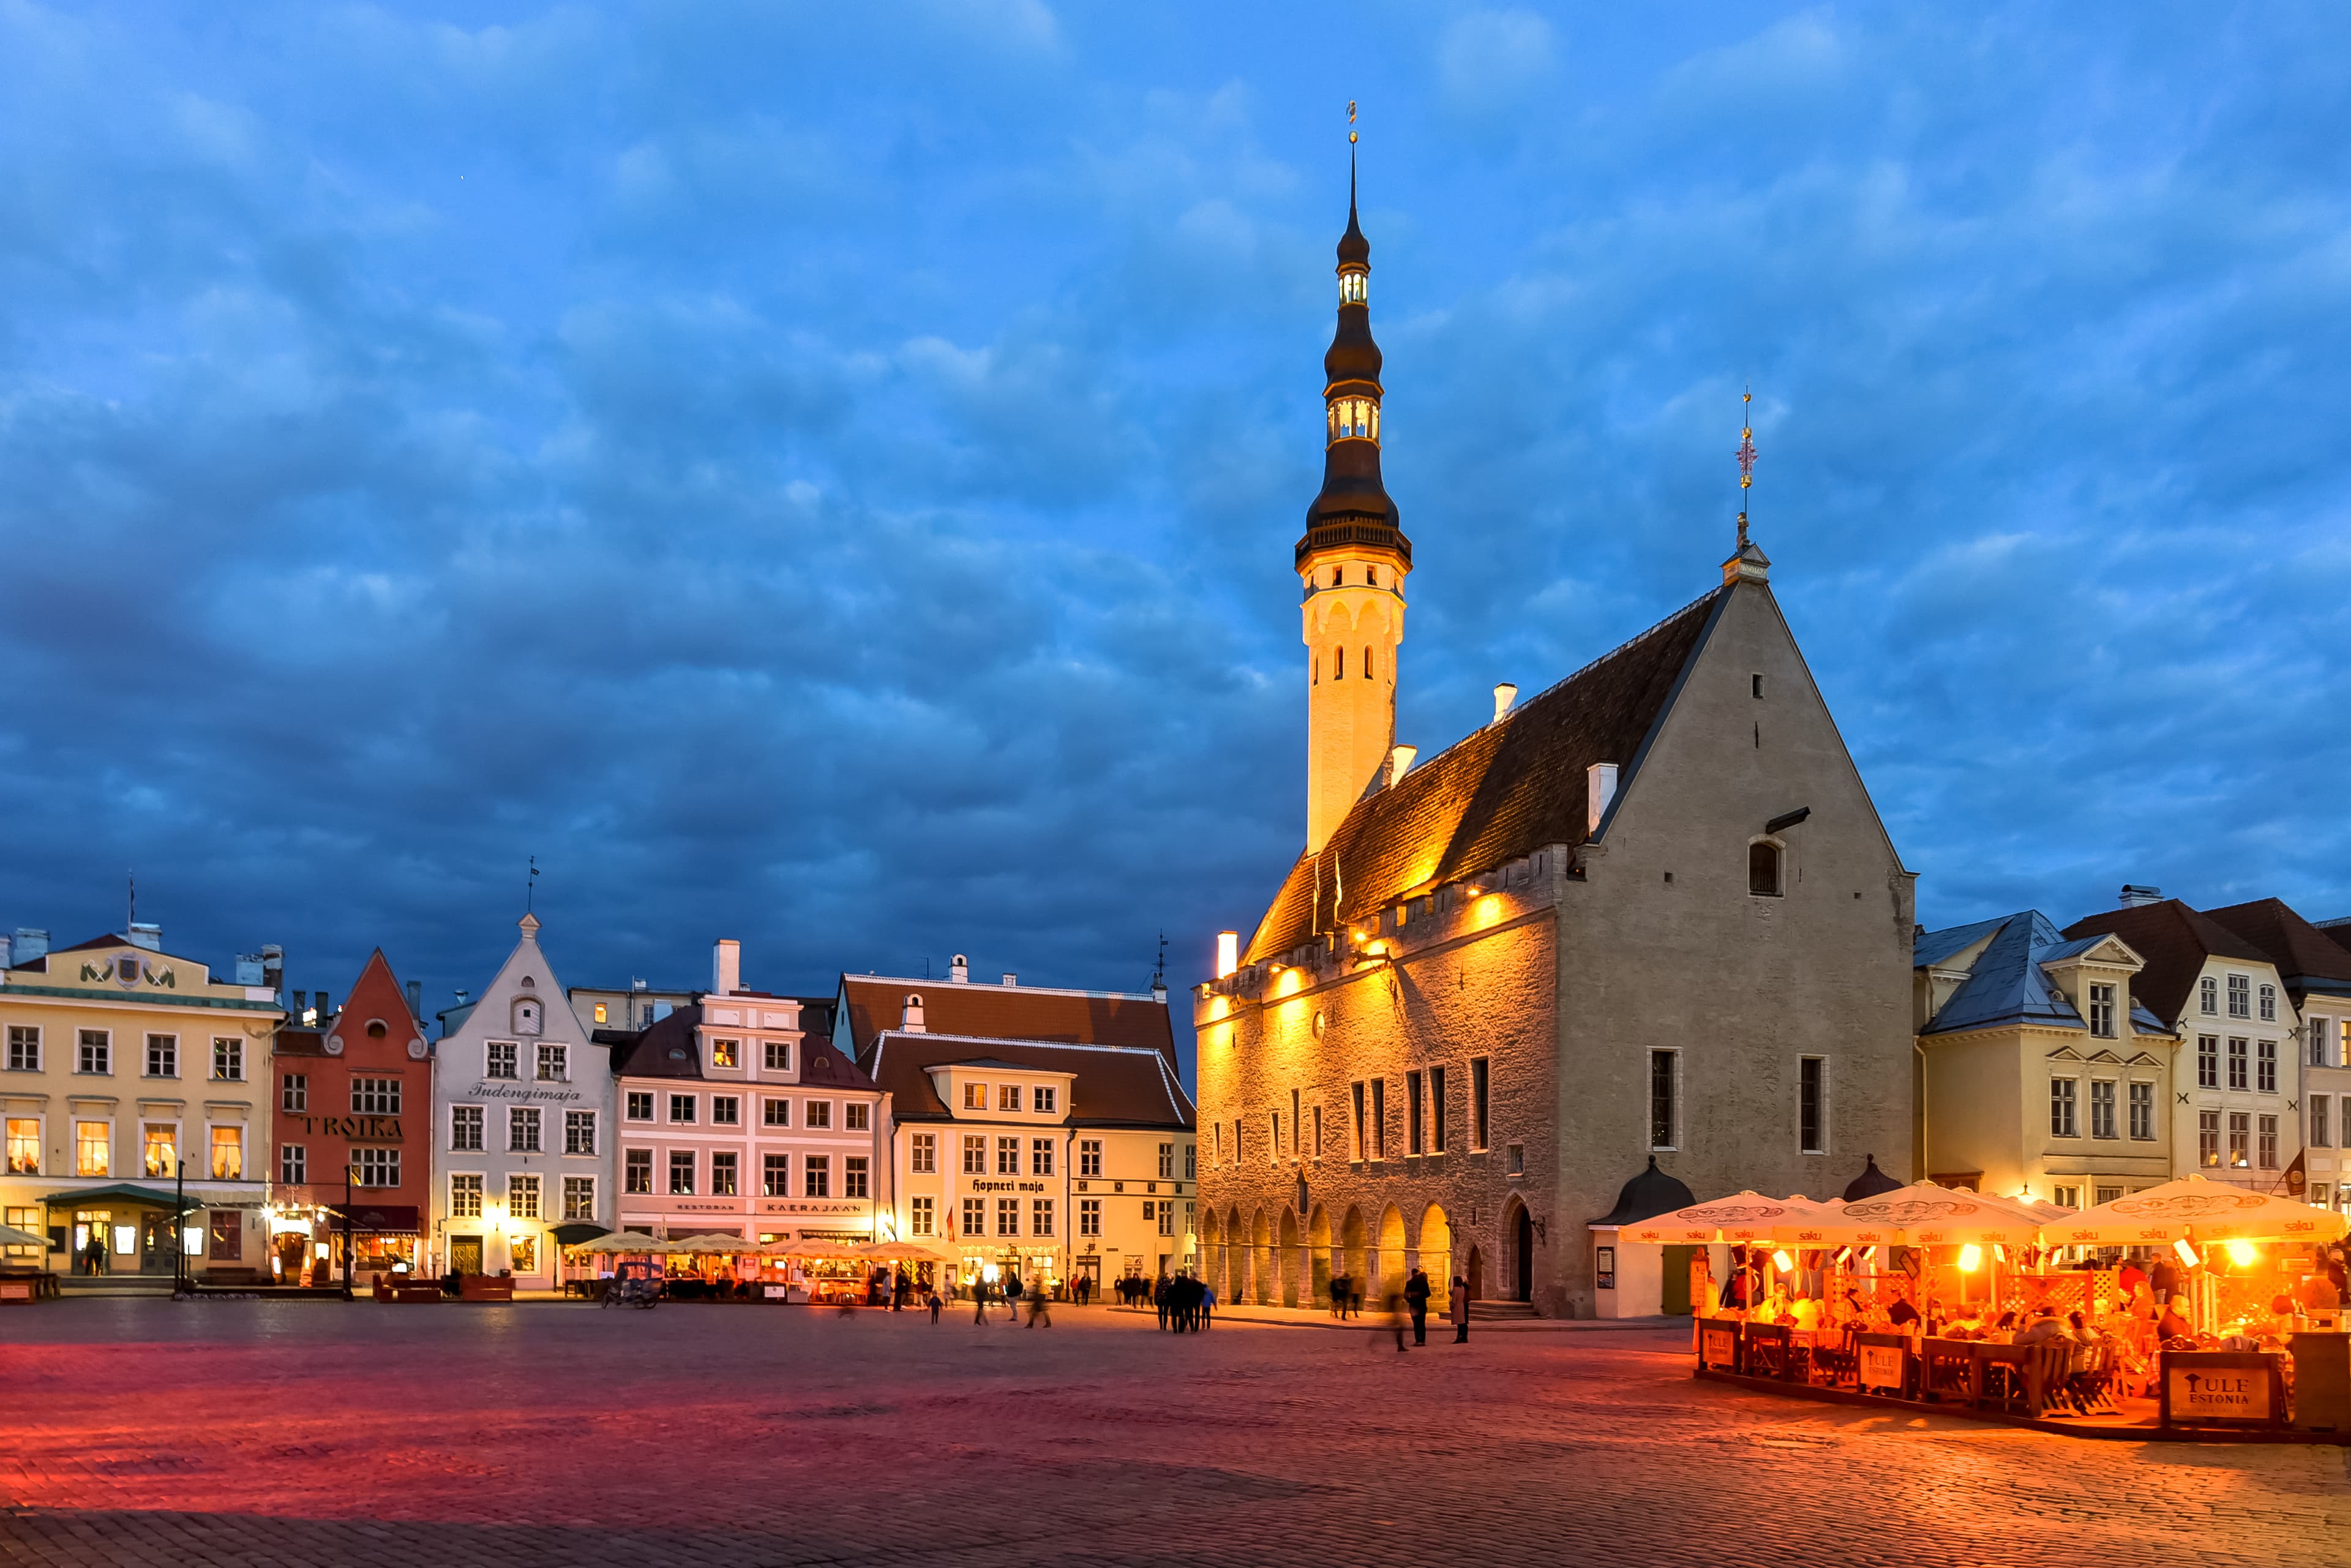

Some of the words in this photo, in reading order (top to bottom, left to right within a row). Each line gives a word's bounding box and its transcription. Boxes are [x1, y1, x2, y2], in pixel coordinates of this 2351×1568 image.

[468, 1082, 582, 1105] Tudengimaja
[300, 1117, 403, 1137] TROIKA
[972, 1179, 1014, 1193] Hopneri
[1019, 1180, 1044, 1194] maja
[2284, 1220, 2315, 1232] saku
[1641, 1231, 1659, 1239] saku
[1686, 1231, 1705, 1239] saku
[1734, 1229, 1754, 1239] saku
[1799, 1231, 1822, 1240] saku
[1856, 1232, 1881, 1242] saku
[1919, 1232, 1943, 1242] saku
[1980, 1231, 2006, 1242] saku
[2072, 1229, 2099, 1240] saku
[2139, 1228, 2168, 1239] saku
[2189, 1394, 2249, 1405] ESTONIA
